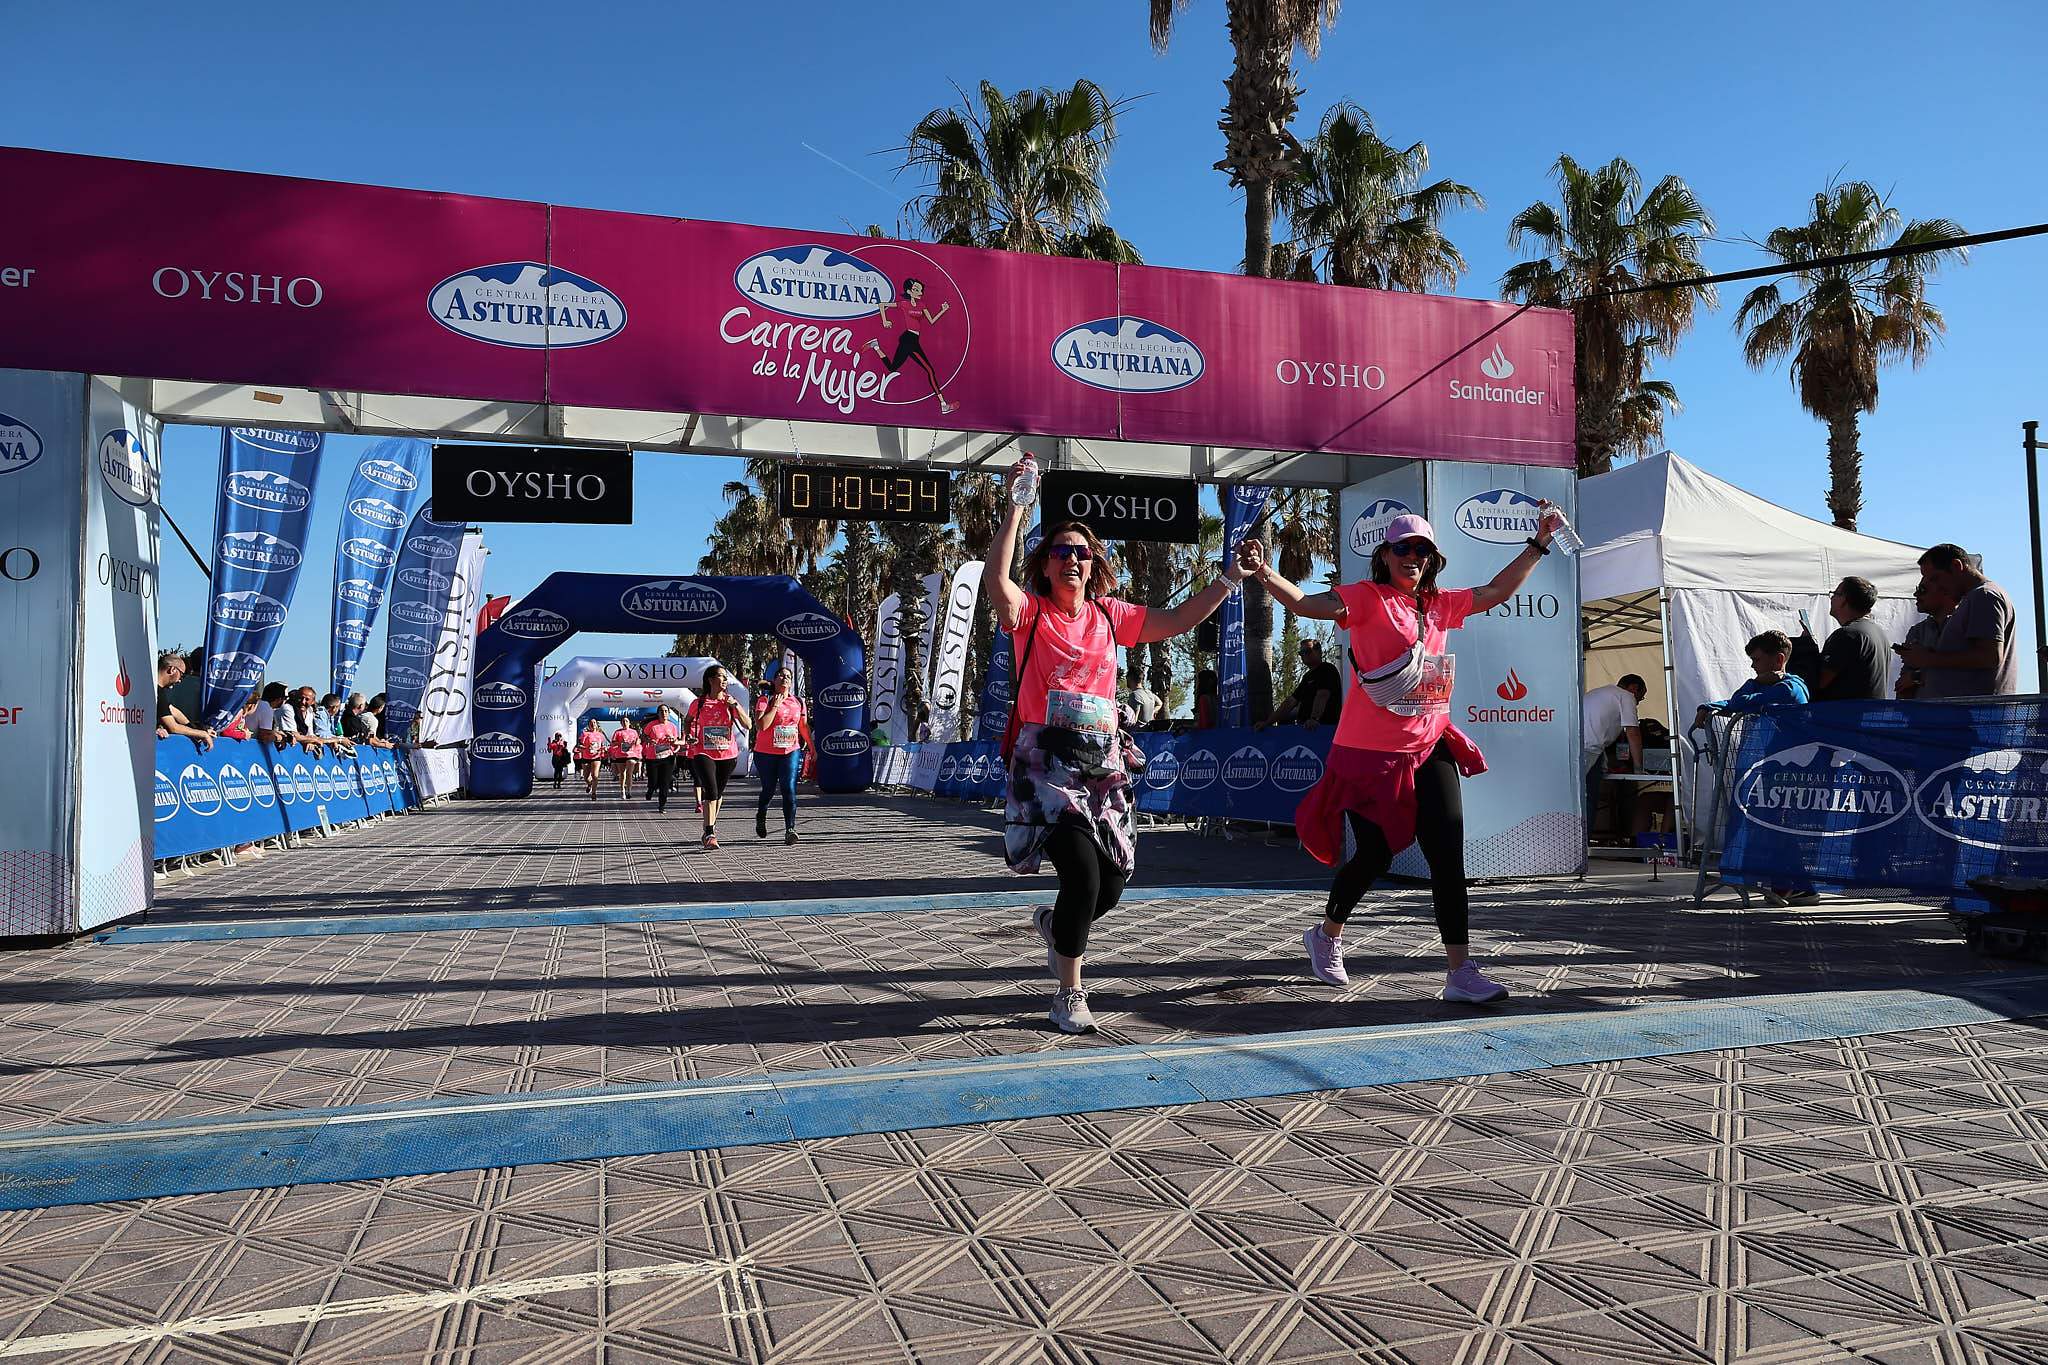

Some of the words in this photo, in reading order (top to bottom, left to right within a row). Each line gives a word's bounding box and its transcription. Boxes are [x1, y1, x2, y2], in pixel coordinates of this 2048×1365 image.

[749, 266, 881, 305] ASTURIANA
[772, 266, 824, 279] CENTRAL
[828, 272, 878, 284] LECHERA
[152, 267, 323, 308] OYSHO
[475, 288, 537, 301] CENTRAL
[444, 288, 612, 330] ASTURIANA
[719, 306, 853, 355] Carrera
[1064, 339, 1194, 376] ASTURIANA
[1087, 340, 1136, 351] CENTRAL
[1140, 343, 1189, 355] LECHERA
[752, 350, 778, 376] de
[783, 350, 801, 379] la
[796, 351, 901, 414] Mujer
[1276, 359, 1386, 391] OYSHO
[1449, 380, 1545, 406] Santander
[364, 464, 413, 489] ASTURIANA
[466, 469, 606, 501] OYSHO
[227, 478, 306, 506] ASTURIANA
[354, 502, 403, 526] ASTURIANA
[1067, 492, 1178, 523] OYSHO
[1462, 508, 1539, 532] ASTURIAN
[222, 541, 295, 566] ASTURIANA
[347, 542, 393, 564] ASTURIANA
[411, 539, 453, 556] ASTURIANA
[98, 552, 152, 600] OYSHO
[402, 572, 445, 589] ASTURIANA
[628, 592, 719, 612] ASTURIANA
[395, 607, 438, 622] ASTURIANA
[504, 619, 564, 632] ASTURIANA
[782, 624, 837, 635] ASTURIANA
[389, 638, 432, 654] ASTURIANA
[425, 571, 467, 718] OYSHO
[936, 582, 973, 710] OYSHO
[604, 663, 687, 680] OYSHO
[874, 616, 901, 724] OYSHO
[475, 691, 523, 704] ASTURIANA
[100, 700, 145, 725] Santander
[1467, 705, 1555, 723] Santander
[474, 741, 521, 753] ASTURIANA
[1146, 765, 1176, 780] ASTURIANA
[1183, 765, 1215, 780] ASTURIANA
[1225, 763, 1264, 779] ASTURIANA
[1274, 763, 1317, 781] ASTURIANA
[1774, 772, 1828, 784] CENTRAL
[1834, 773, 1890, 785] LECHERA
[1747, 773, 1895, 815] ASTURIANA
